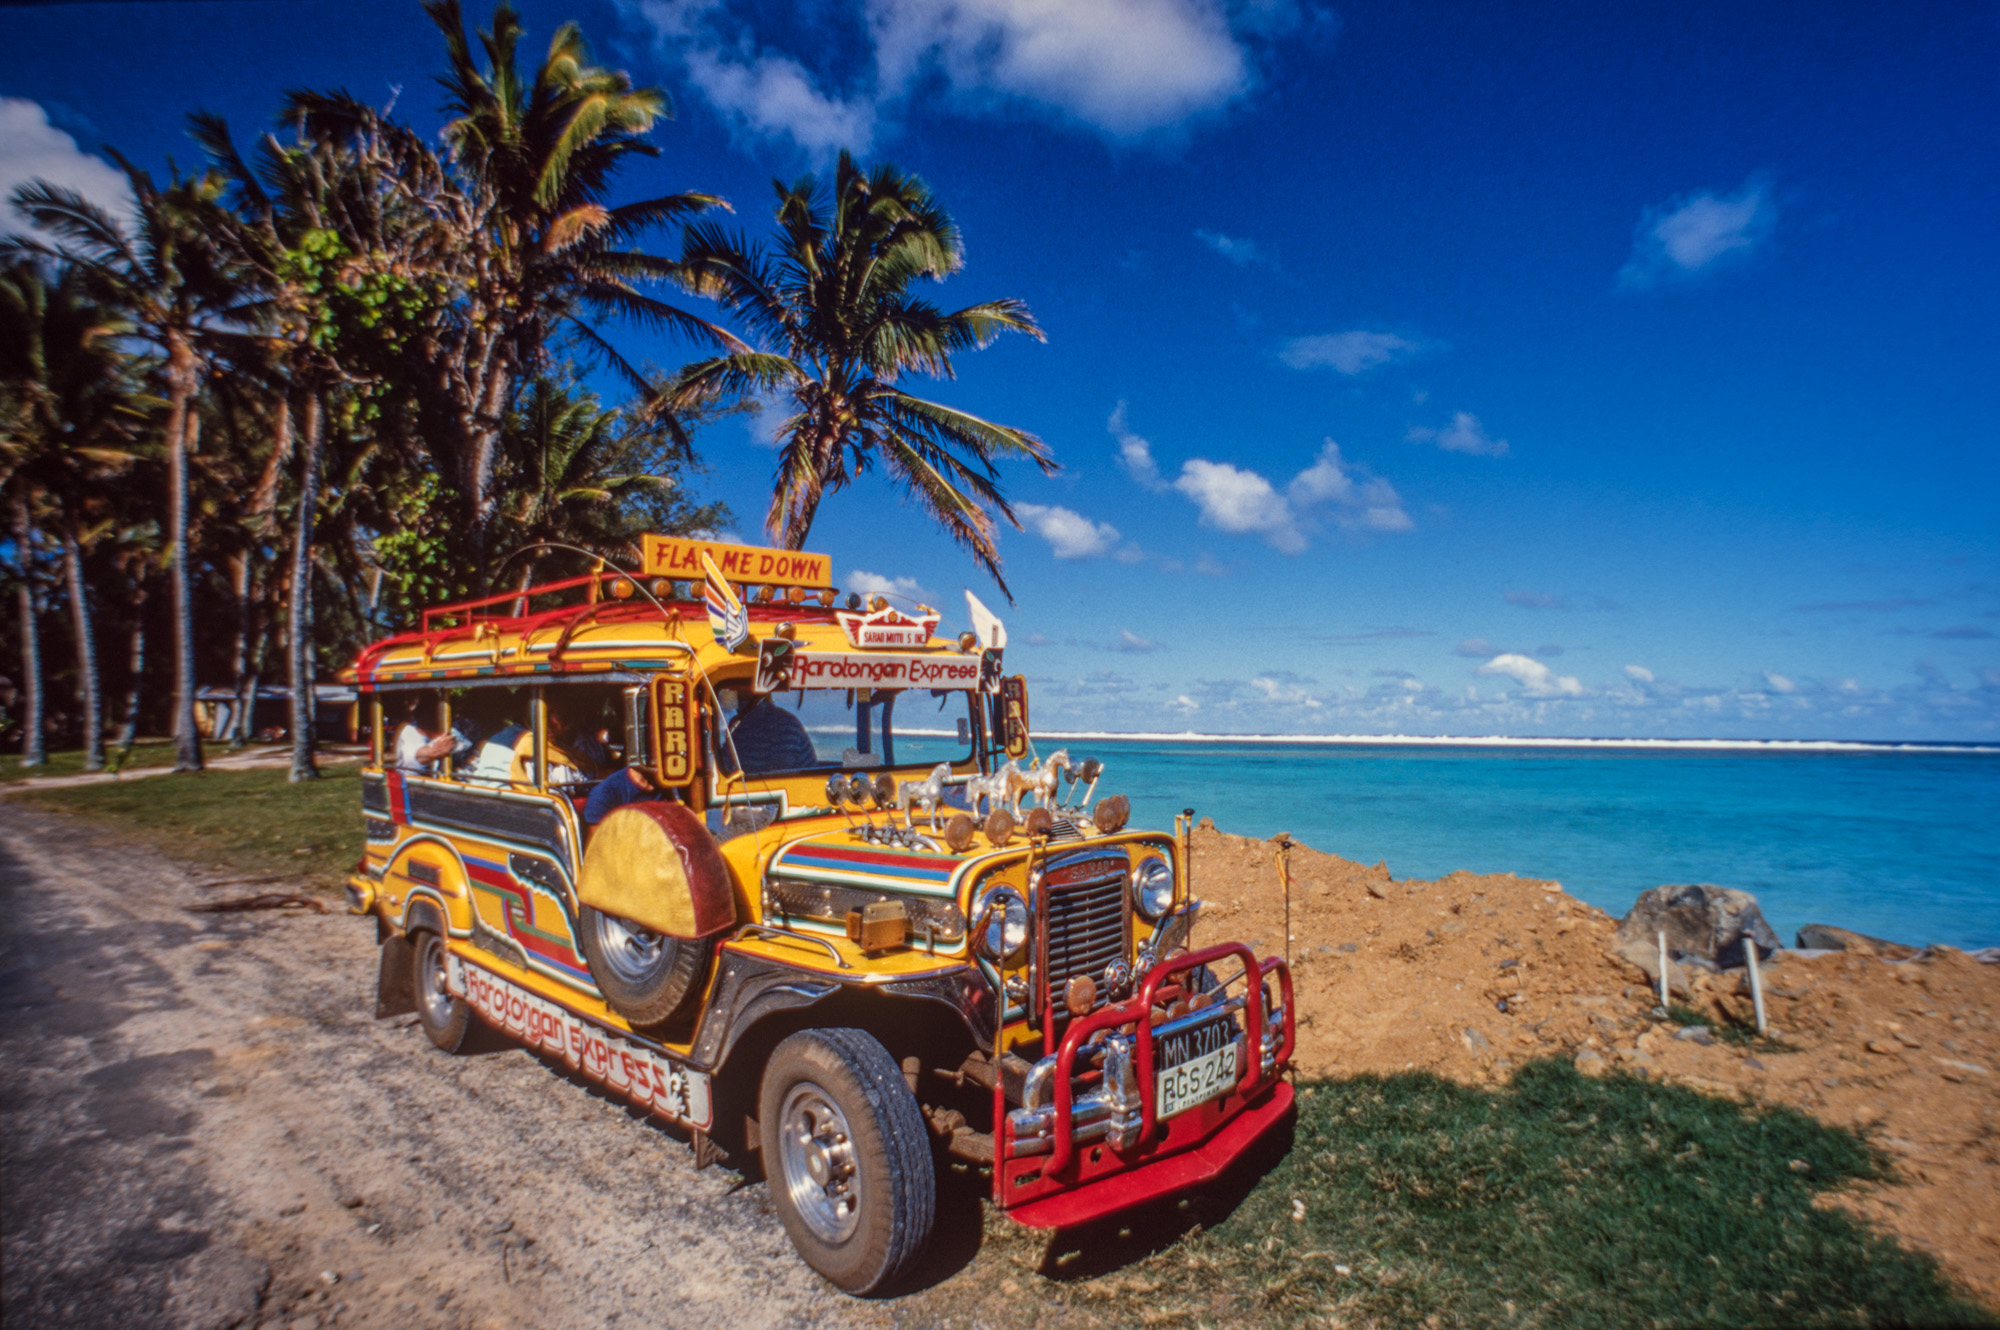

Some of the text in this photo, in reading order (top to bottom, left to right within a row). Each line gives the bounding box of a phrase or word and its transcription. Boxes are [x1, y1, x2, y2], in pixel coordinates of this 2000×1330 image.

[721, 551, 754, 575] ME
[759, 555, 822, 581] DOWN
[791, 654, 977, 685] Rarotongan Express
[663, 682, 687, 776] RARO
[468, 969, 565, 1040] Rarotongan
[1164, 1020, 1229, 1070] MN 3703
